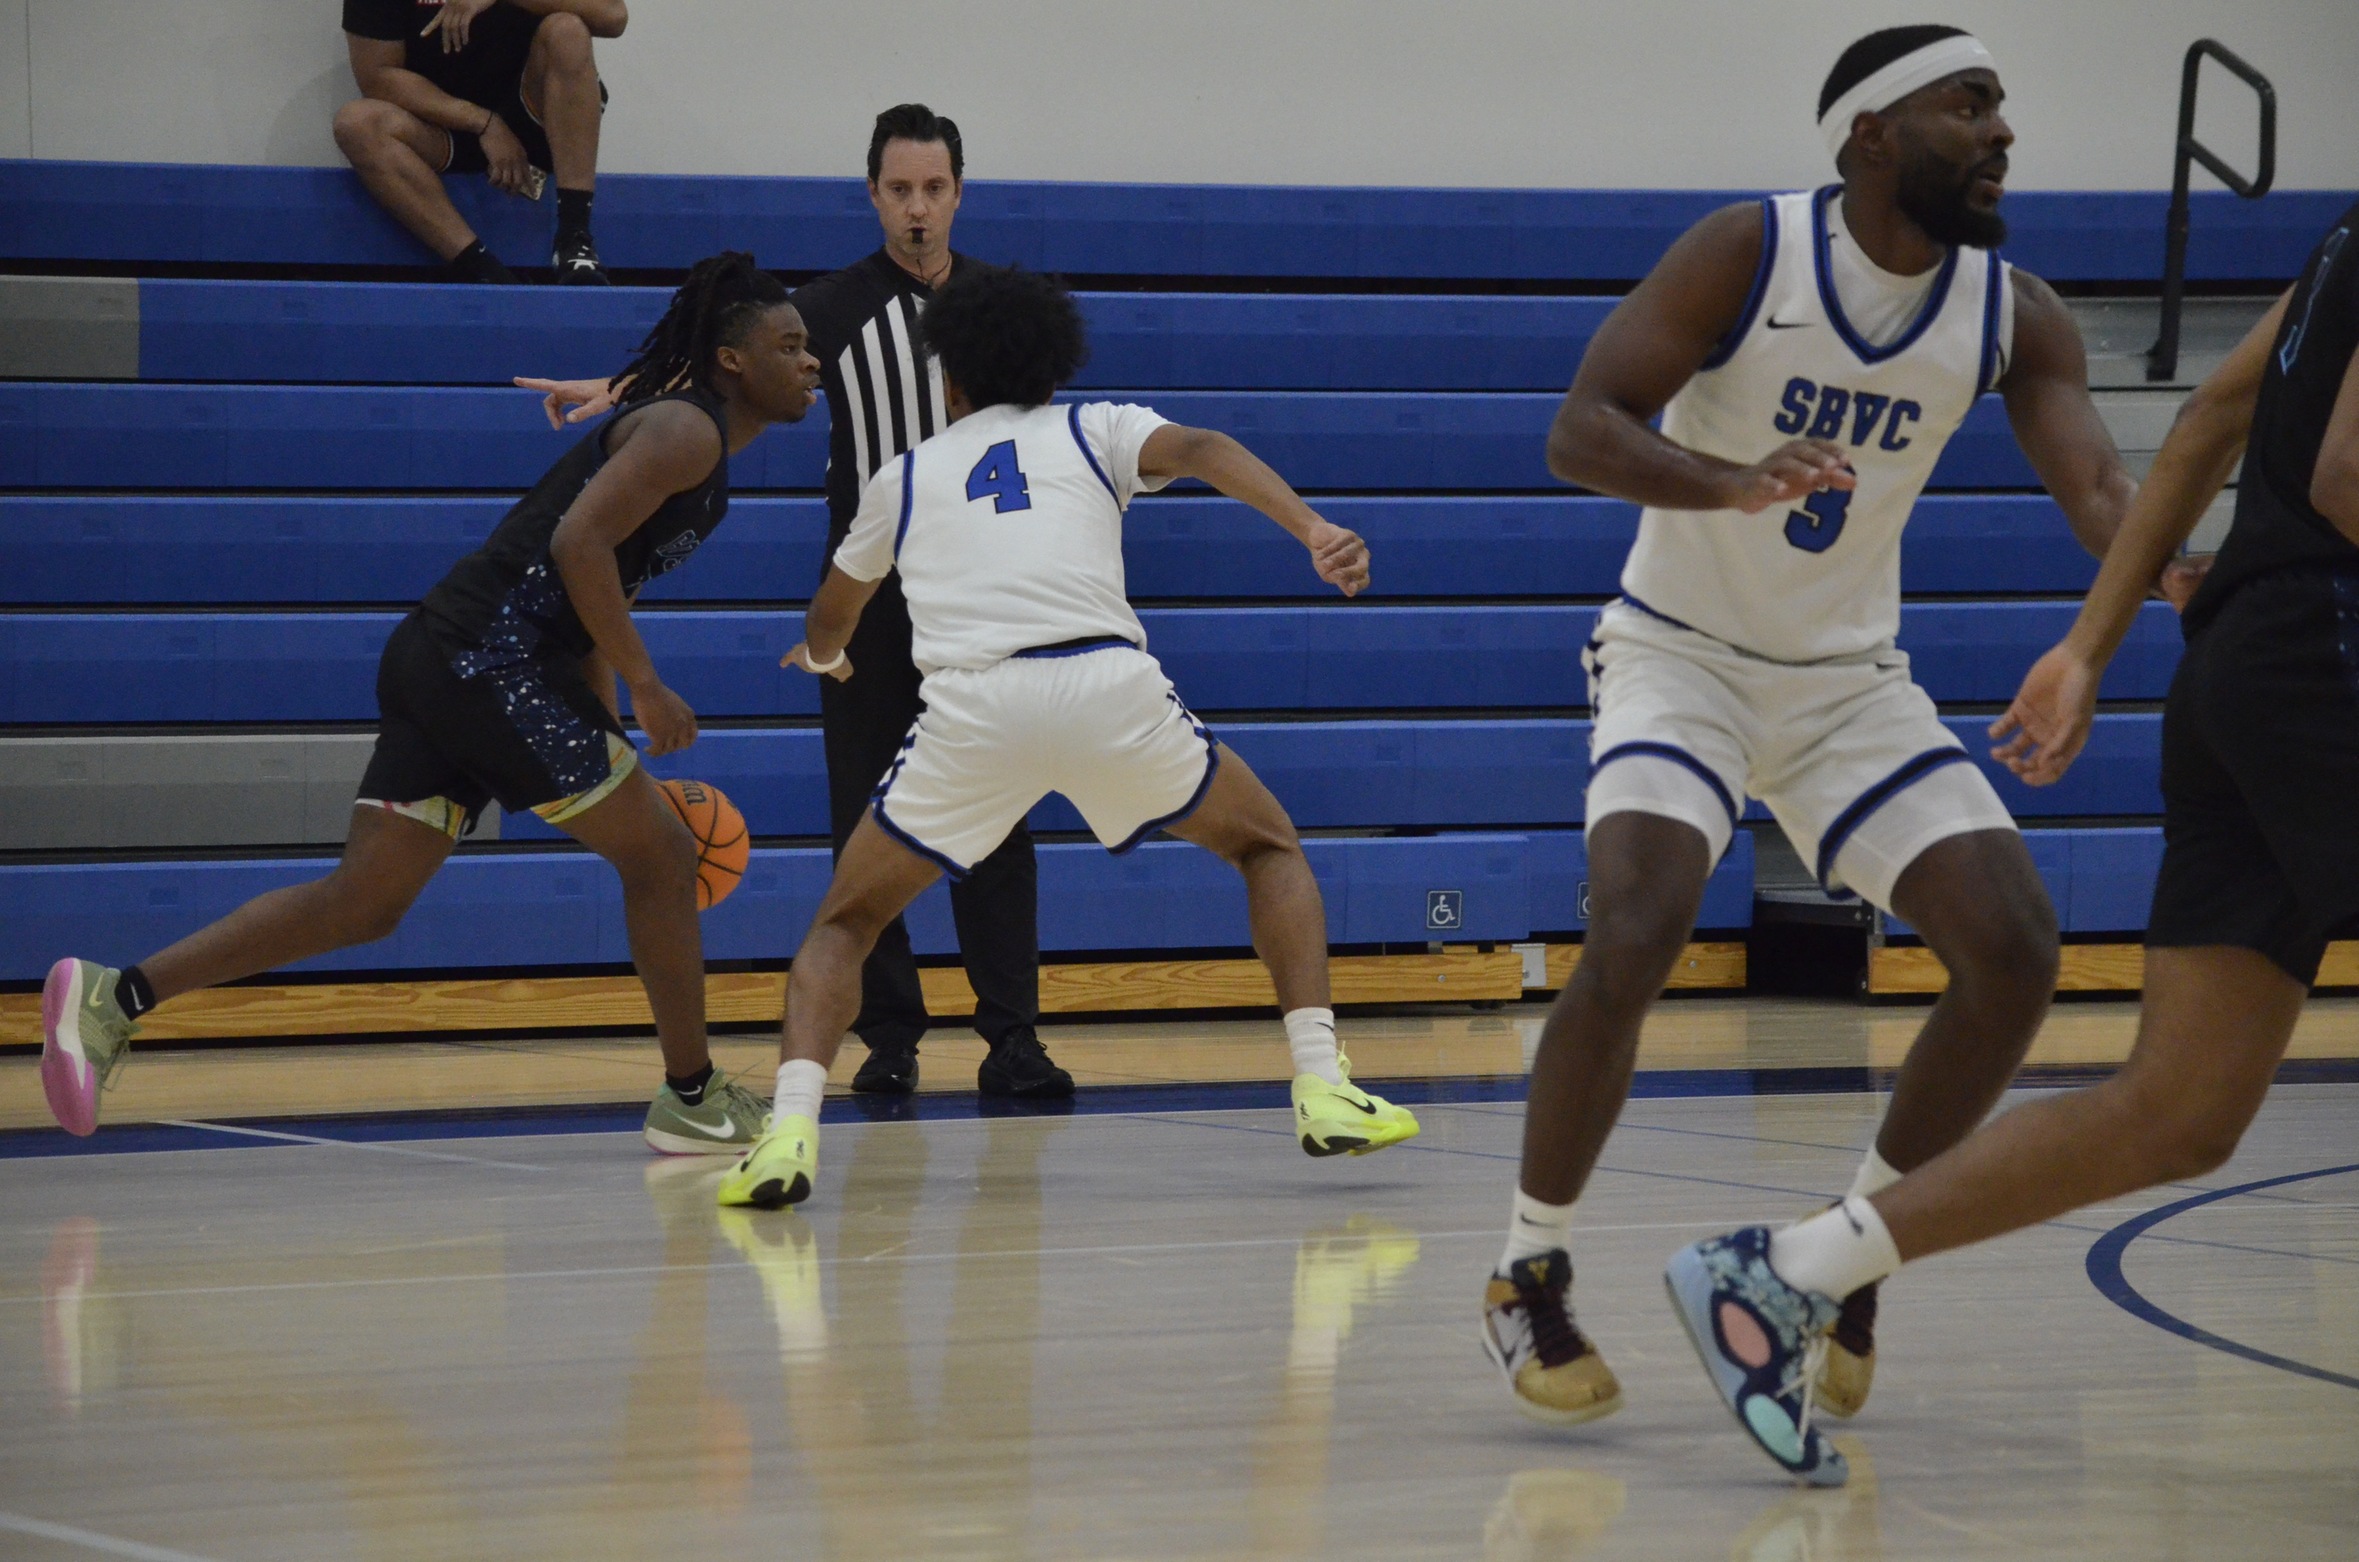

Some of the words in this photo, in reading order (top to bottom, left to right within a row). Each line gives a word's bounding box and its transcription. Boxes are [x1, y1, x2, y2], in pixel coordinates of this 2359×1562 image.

[1774, 376, 1922, 452] SBVC
[965, 439, 1032, 514] 4
[1784, 463, 1857, 553] 3
